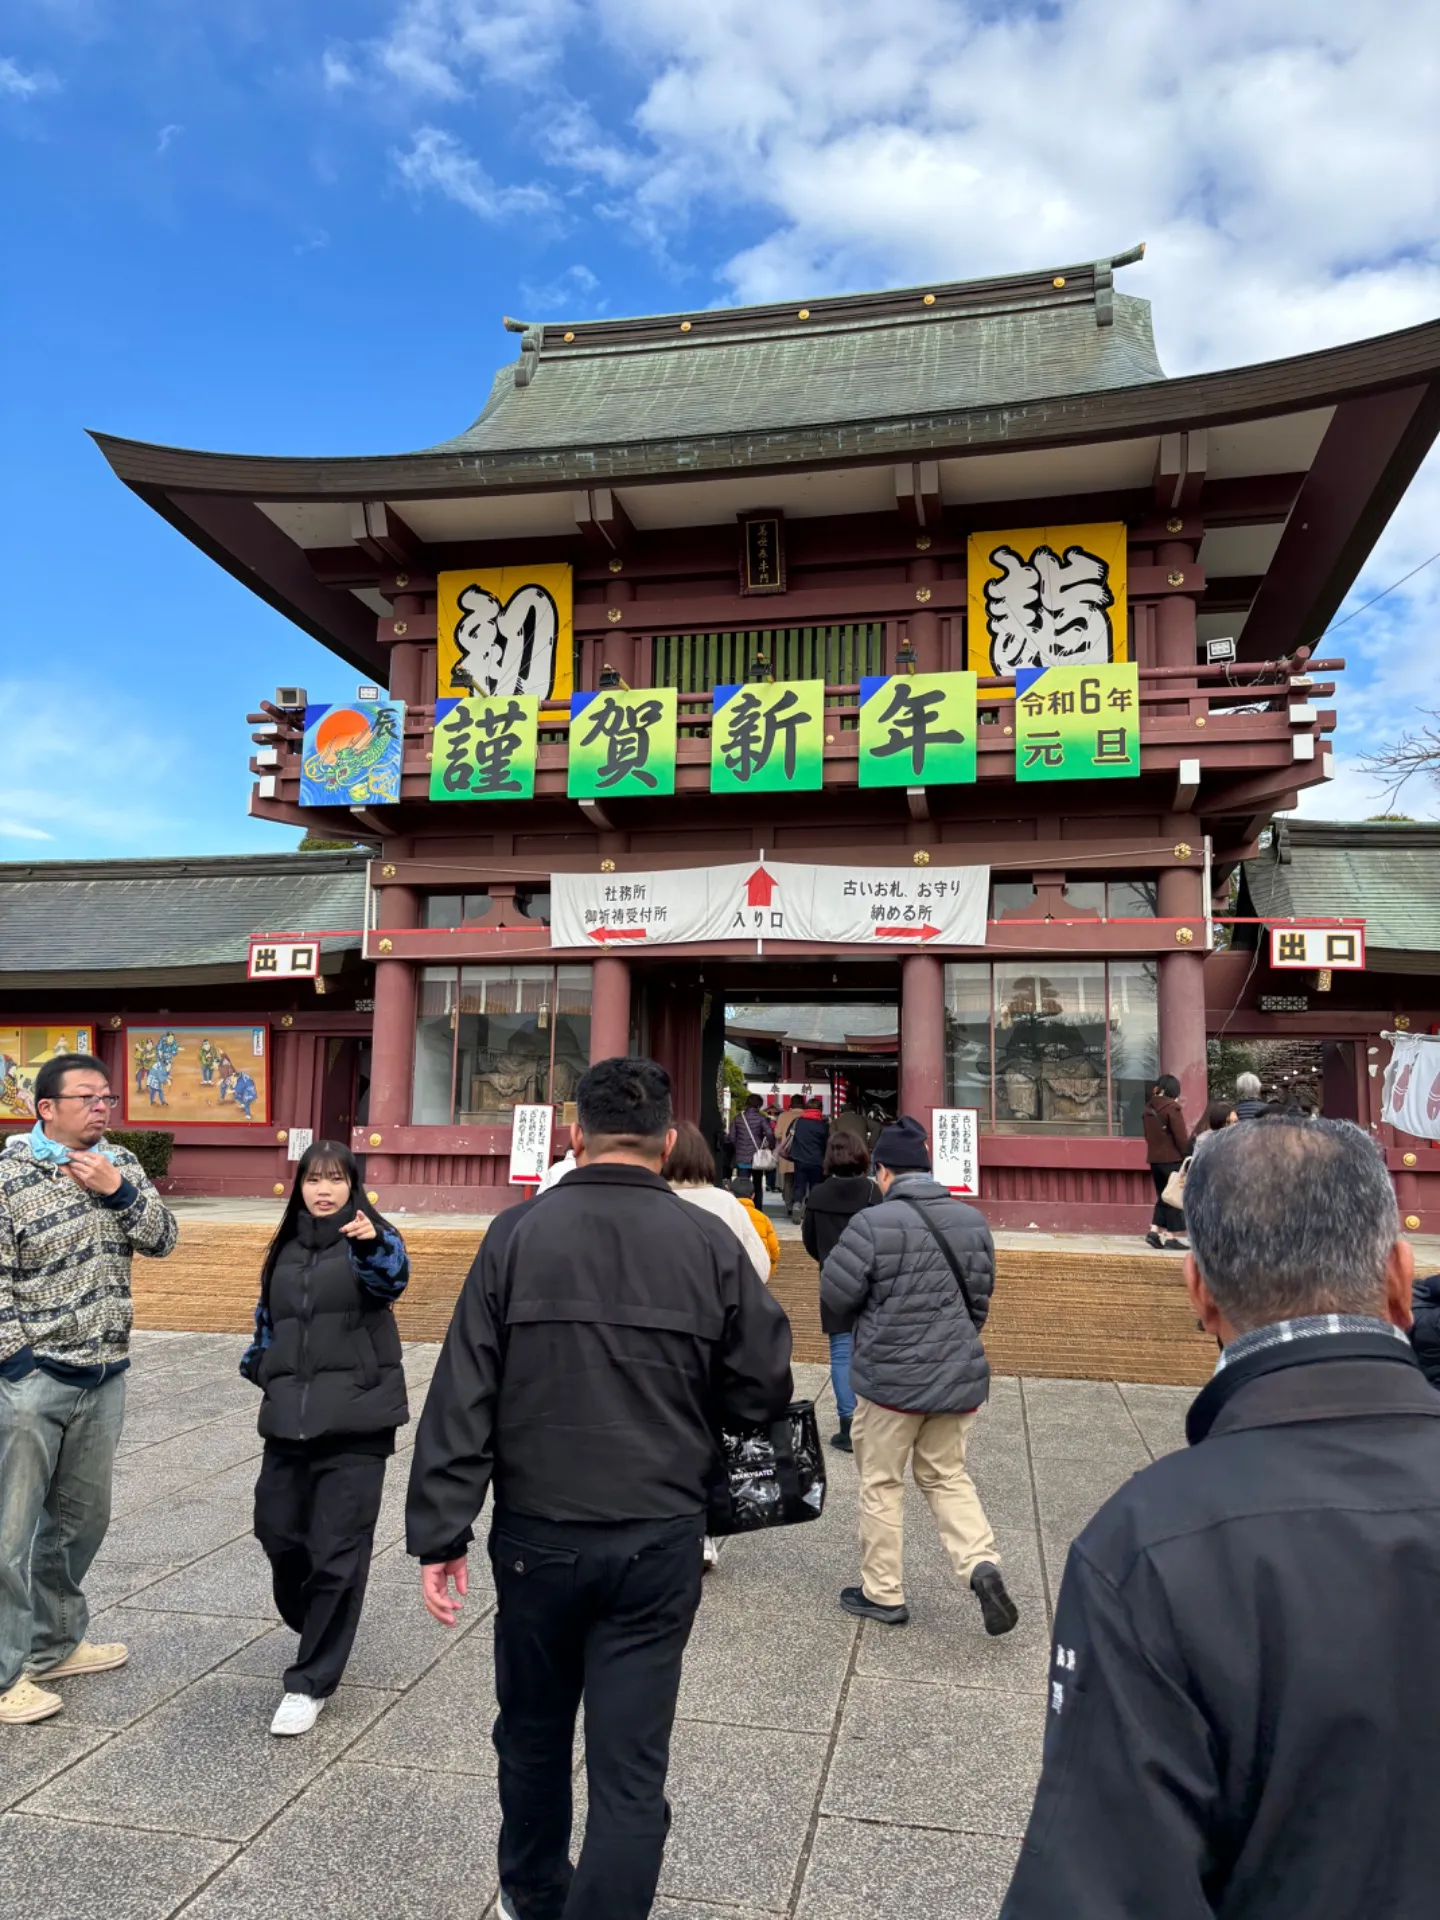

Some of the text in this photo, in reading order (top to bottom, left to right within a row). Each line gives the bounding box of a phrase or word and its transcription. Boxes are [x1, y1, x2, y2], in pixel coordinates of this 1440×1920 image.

[1020, 678, 1133, 717] 令和6年
[372, 708, 399, 740] 辰
[604, 884, 647, 902] 社務所
[584, 905, 668, 926] 御祈祷受付所
[732, 911, 783, 929] 入り口
[870, 904, 933, 922] 納める所
[1278, 932, 1356, 962] 出口
[255, 948, 313, 972] 出口
